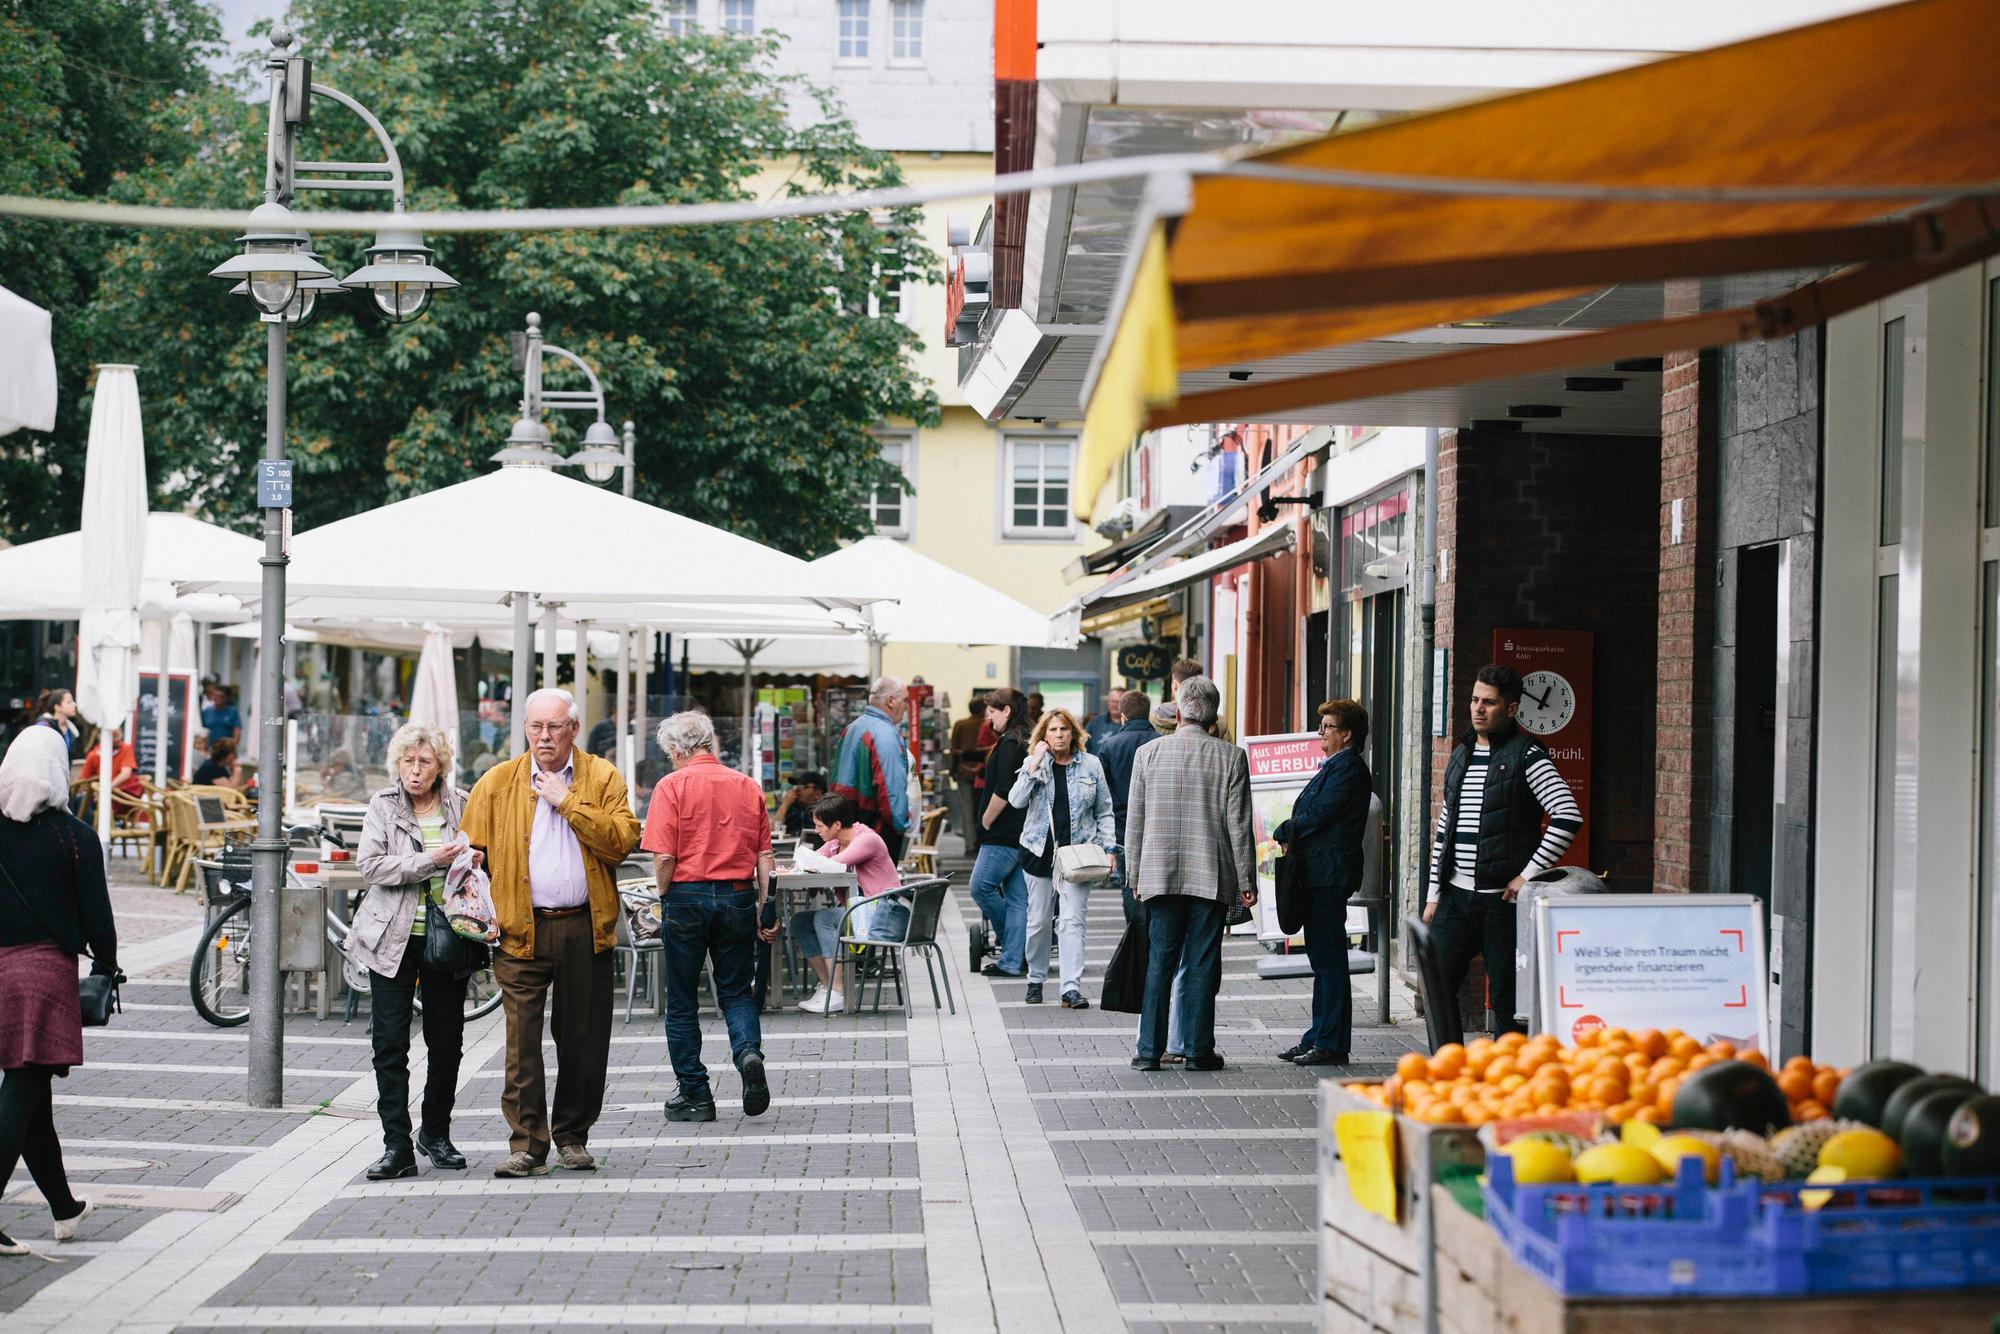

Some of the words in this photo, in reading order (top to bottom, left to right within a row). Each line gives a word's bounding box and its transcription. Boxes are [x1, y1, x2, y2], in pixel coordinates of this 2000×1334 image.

[266, 466, 275, 477] S
[1252, 747, 1270, 759] Aus
[1274, 741, 1310, 755] unserer
[1548, 748, 1585, 760] Brühl.
[1574, 947, 1601, 957] Weil
[1604, 947, 1621, 957] Sie
[1624, 947, 1656, 957] Ihren
[1659, 946, 1696, 956] Traum
[1699, 946, 1729, 957] nicht
[1575, 962, 1633, 975] irgendwie
[1637, 961, 1704, 973] finanzieren
